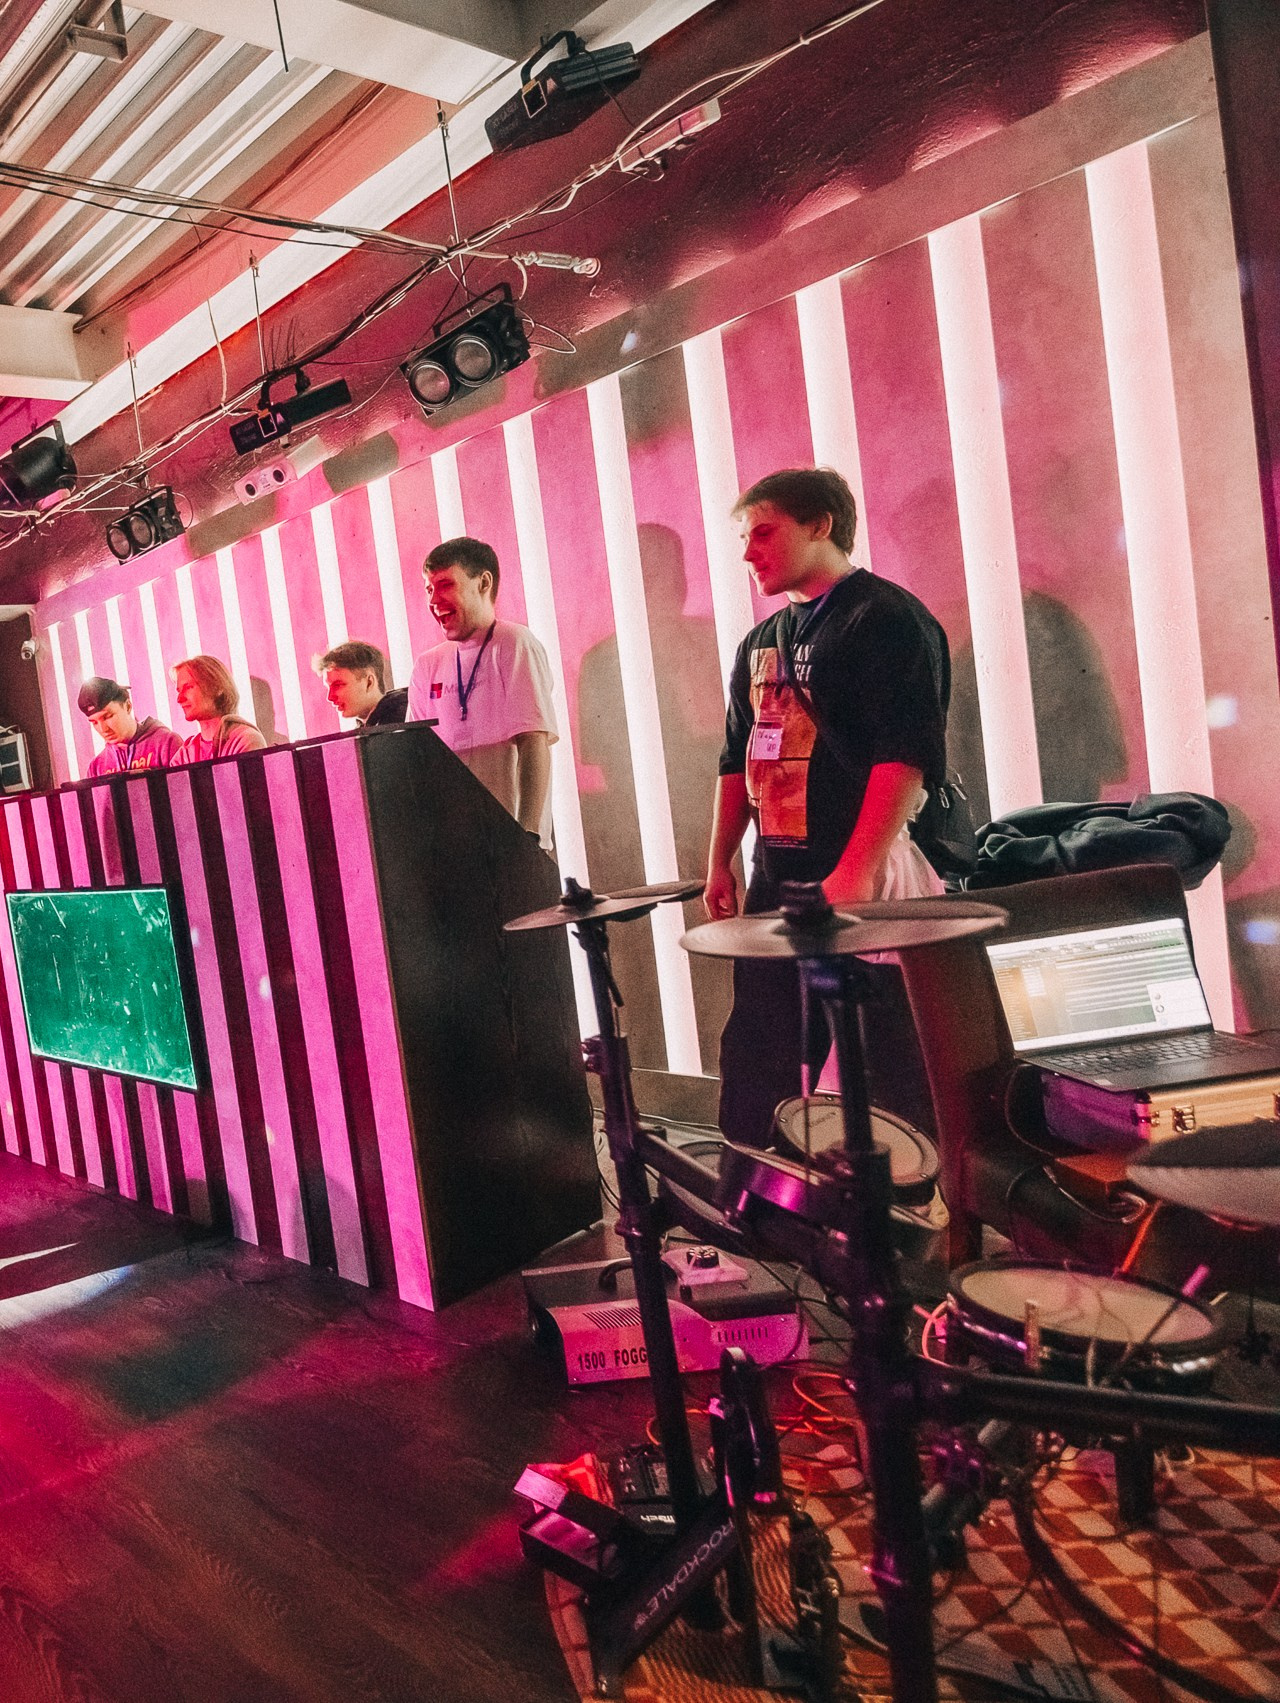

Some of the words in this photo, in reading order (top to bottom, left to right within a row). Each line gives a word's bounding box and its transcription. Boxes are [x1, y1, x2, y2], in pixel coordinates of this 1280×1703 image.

[578, 1351, 606, 1370] 1500
[614, 1346, 648, 1367] FOGG
[646, 1516, 735, 1616] ROCKDALE
